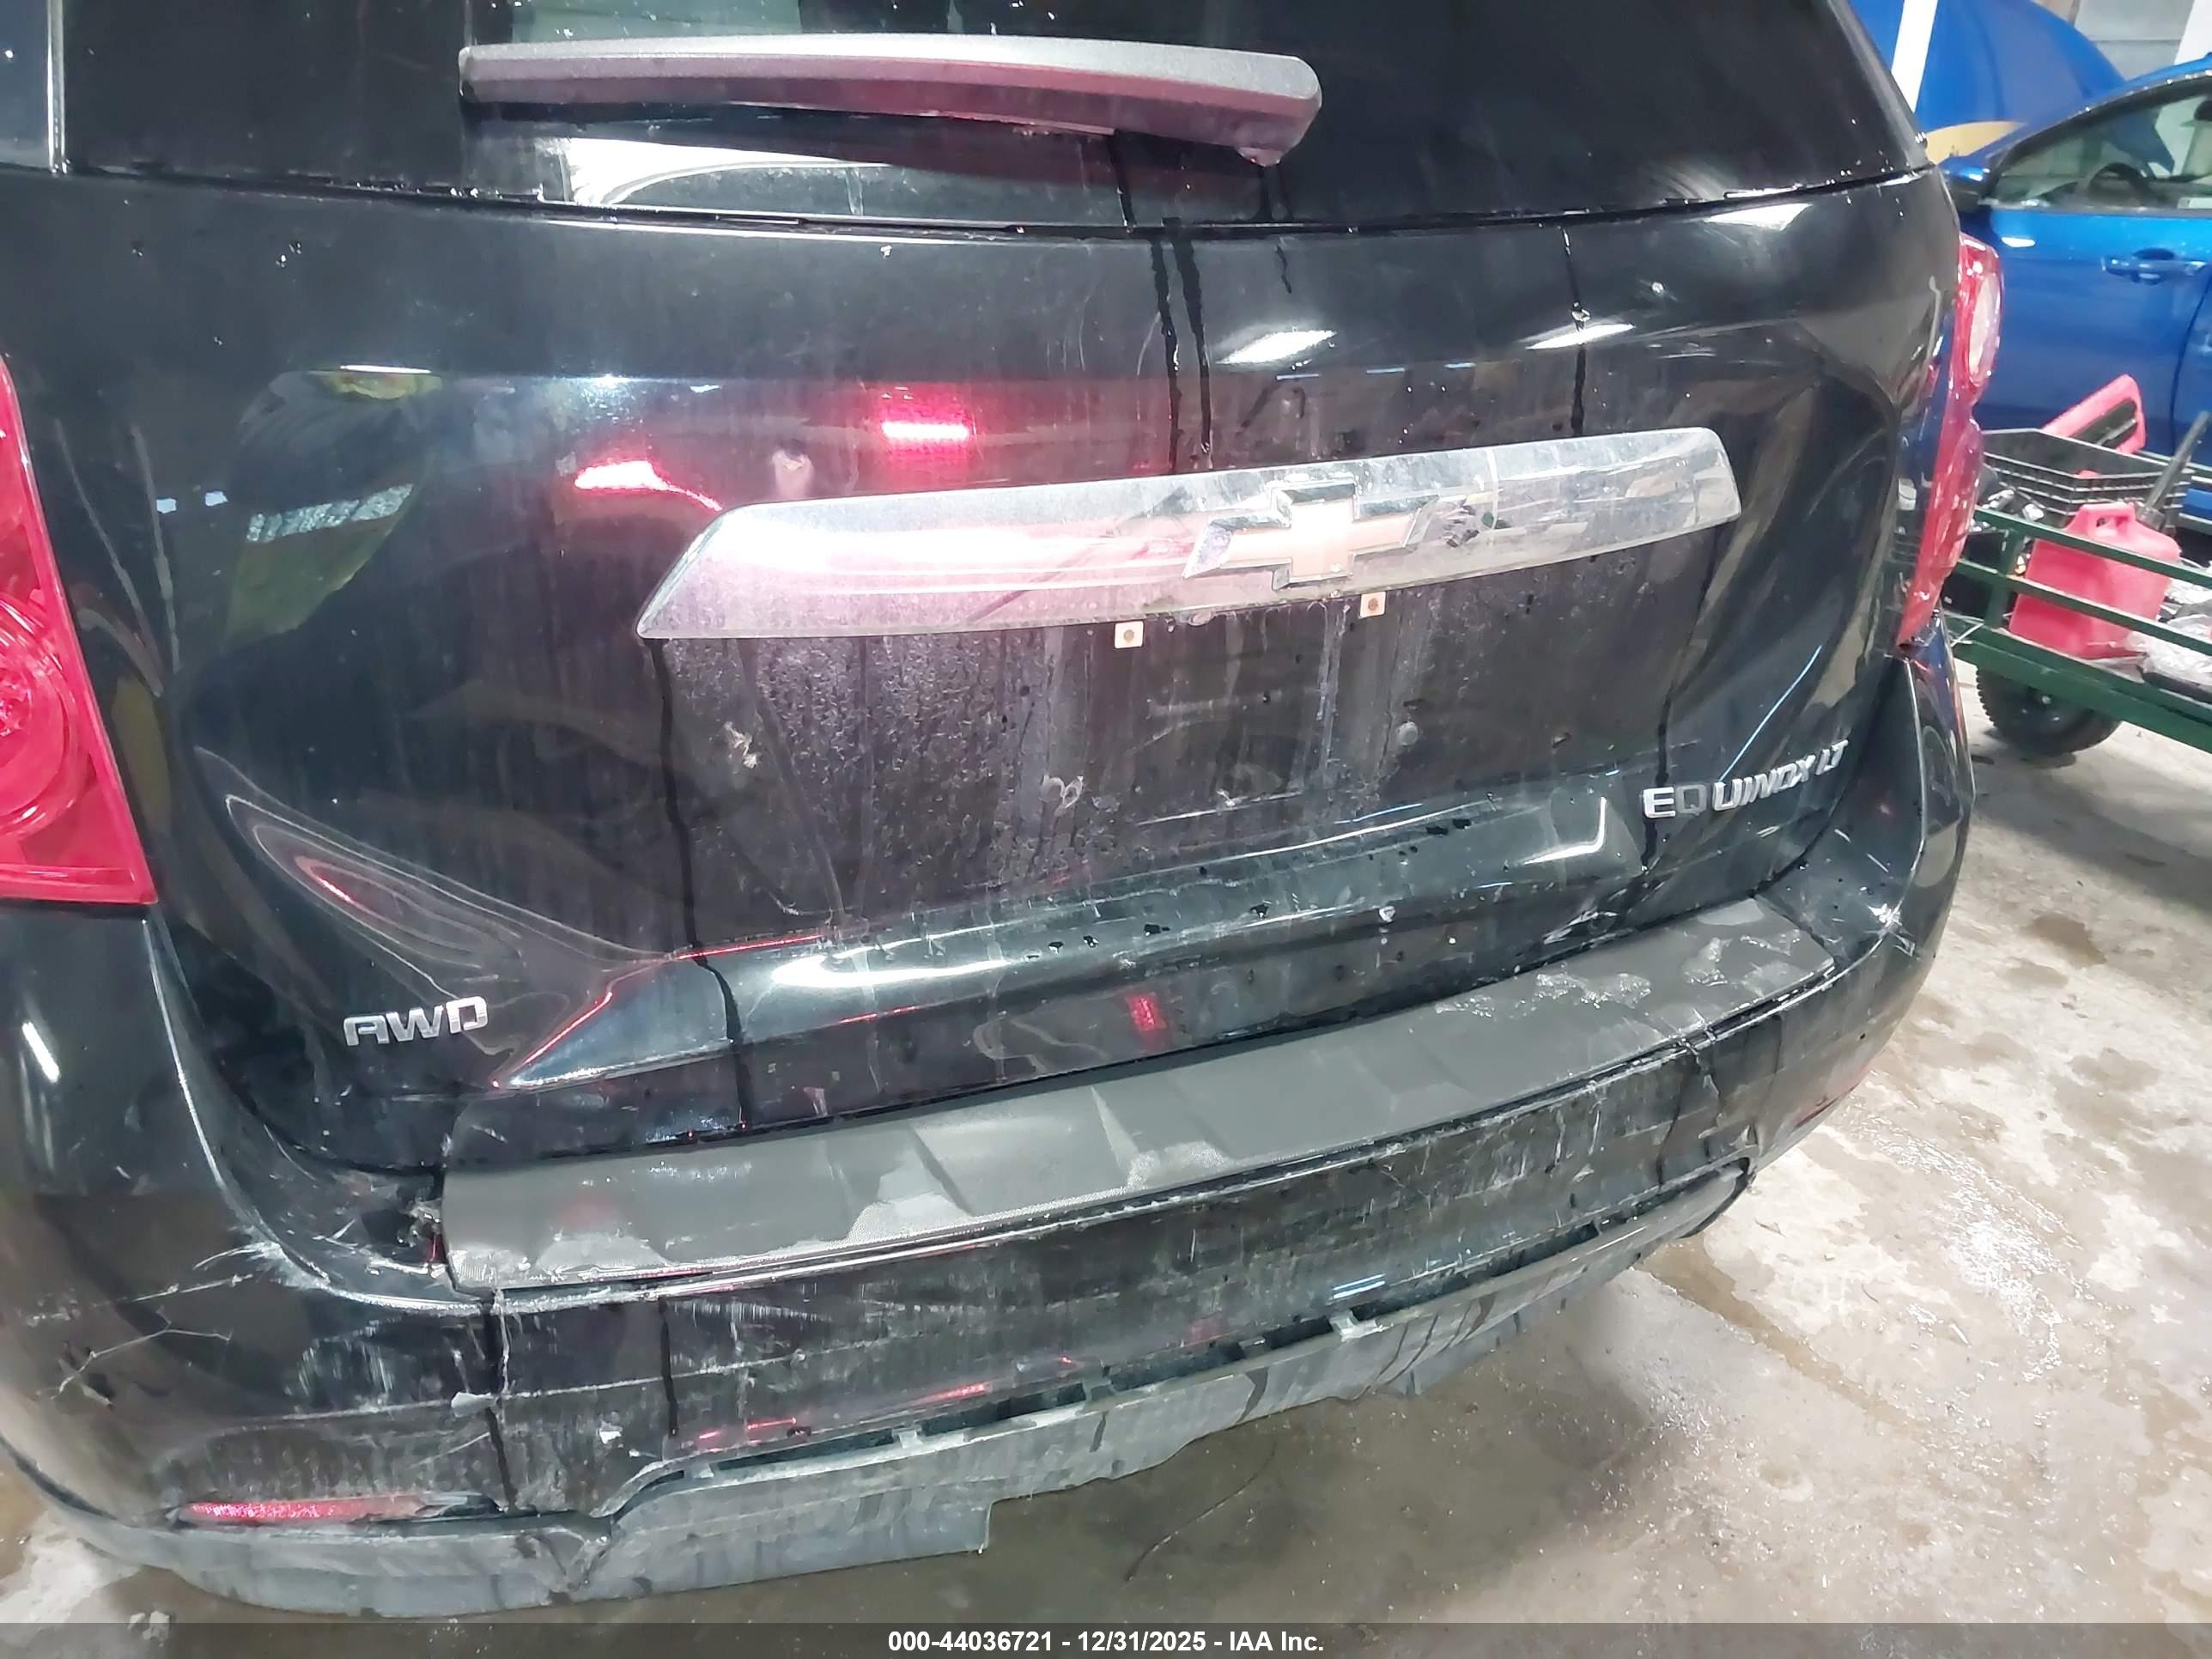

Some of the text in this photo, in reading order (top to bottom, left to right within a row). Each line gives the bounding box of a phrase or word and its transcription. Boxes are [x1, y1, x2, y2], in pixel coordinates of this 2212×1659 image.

[1643, 739, 1849, 818] EQUINOX LT
[343, 995, 489, 1047] AWD
